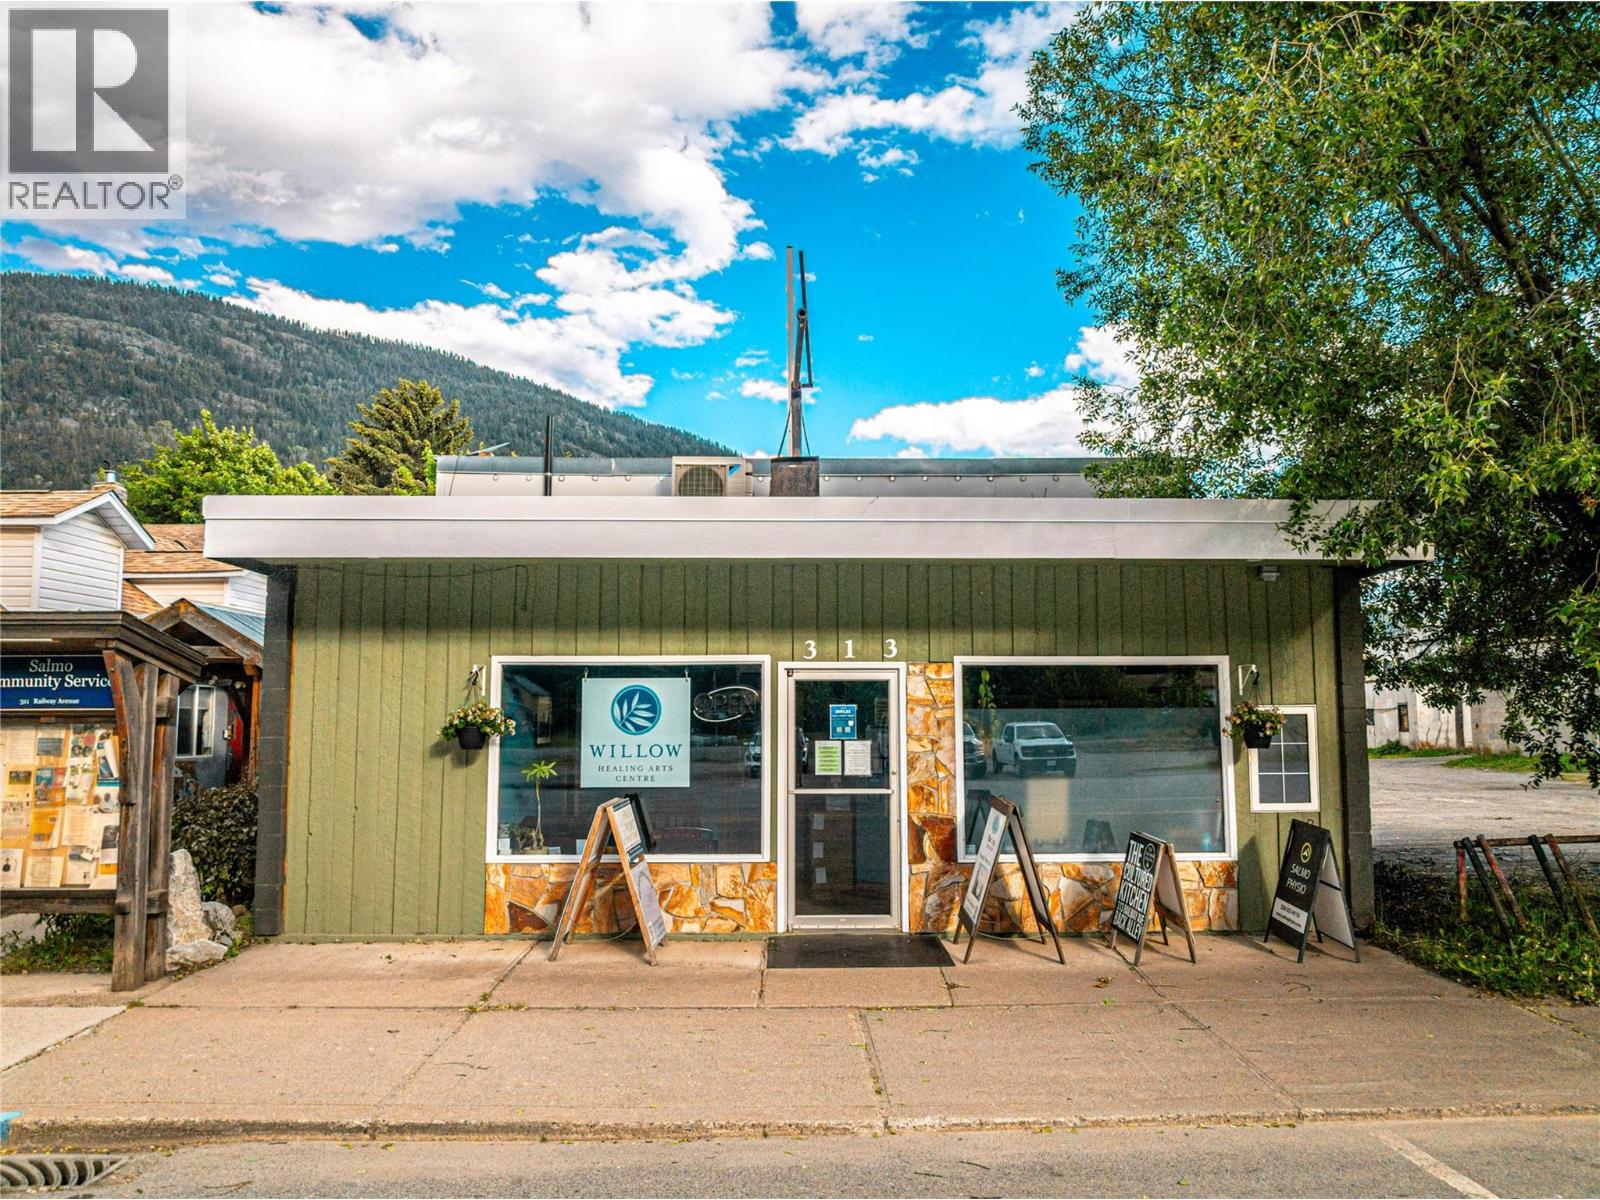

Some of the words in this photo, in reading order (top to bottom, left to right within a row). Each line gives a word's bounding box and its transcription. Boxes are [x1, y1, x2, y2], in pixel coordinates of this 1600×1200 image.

[29, 658, 73, 672] Salmo
[33, 697, 56, 705] Railway
[57, 697, 80, 705] Avenue
[589, 743, 683, 758] WILLOW
[598, 764, 644, 773] HEALING
[648, 764, 674, 772] ARTS
[615, 774, 656, 783] CENTRE
[1128, 840, 1144, 867] THE
[1123, 862, 1153, 892] CULTURED
[1290, 863, 1311, 880] SALMO
[1285, 877, 1307, 894] PHYSIO
[1118, 880, 1150, 916] KITCHEN
